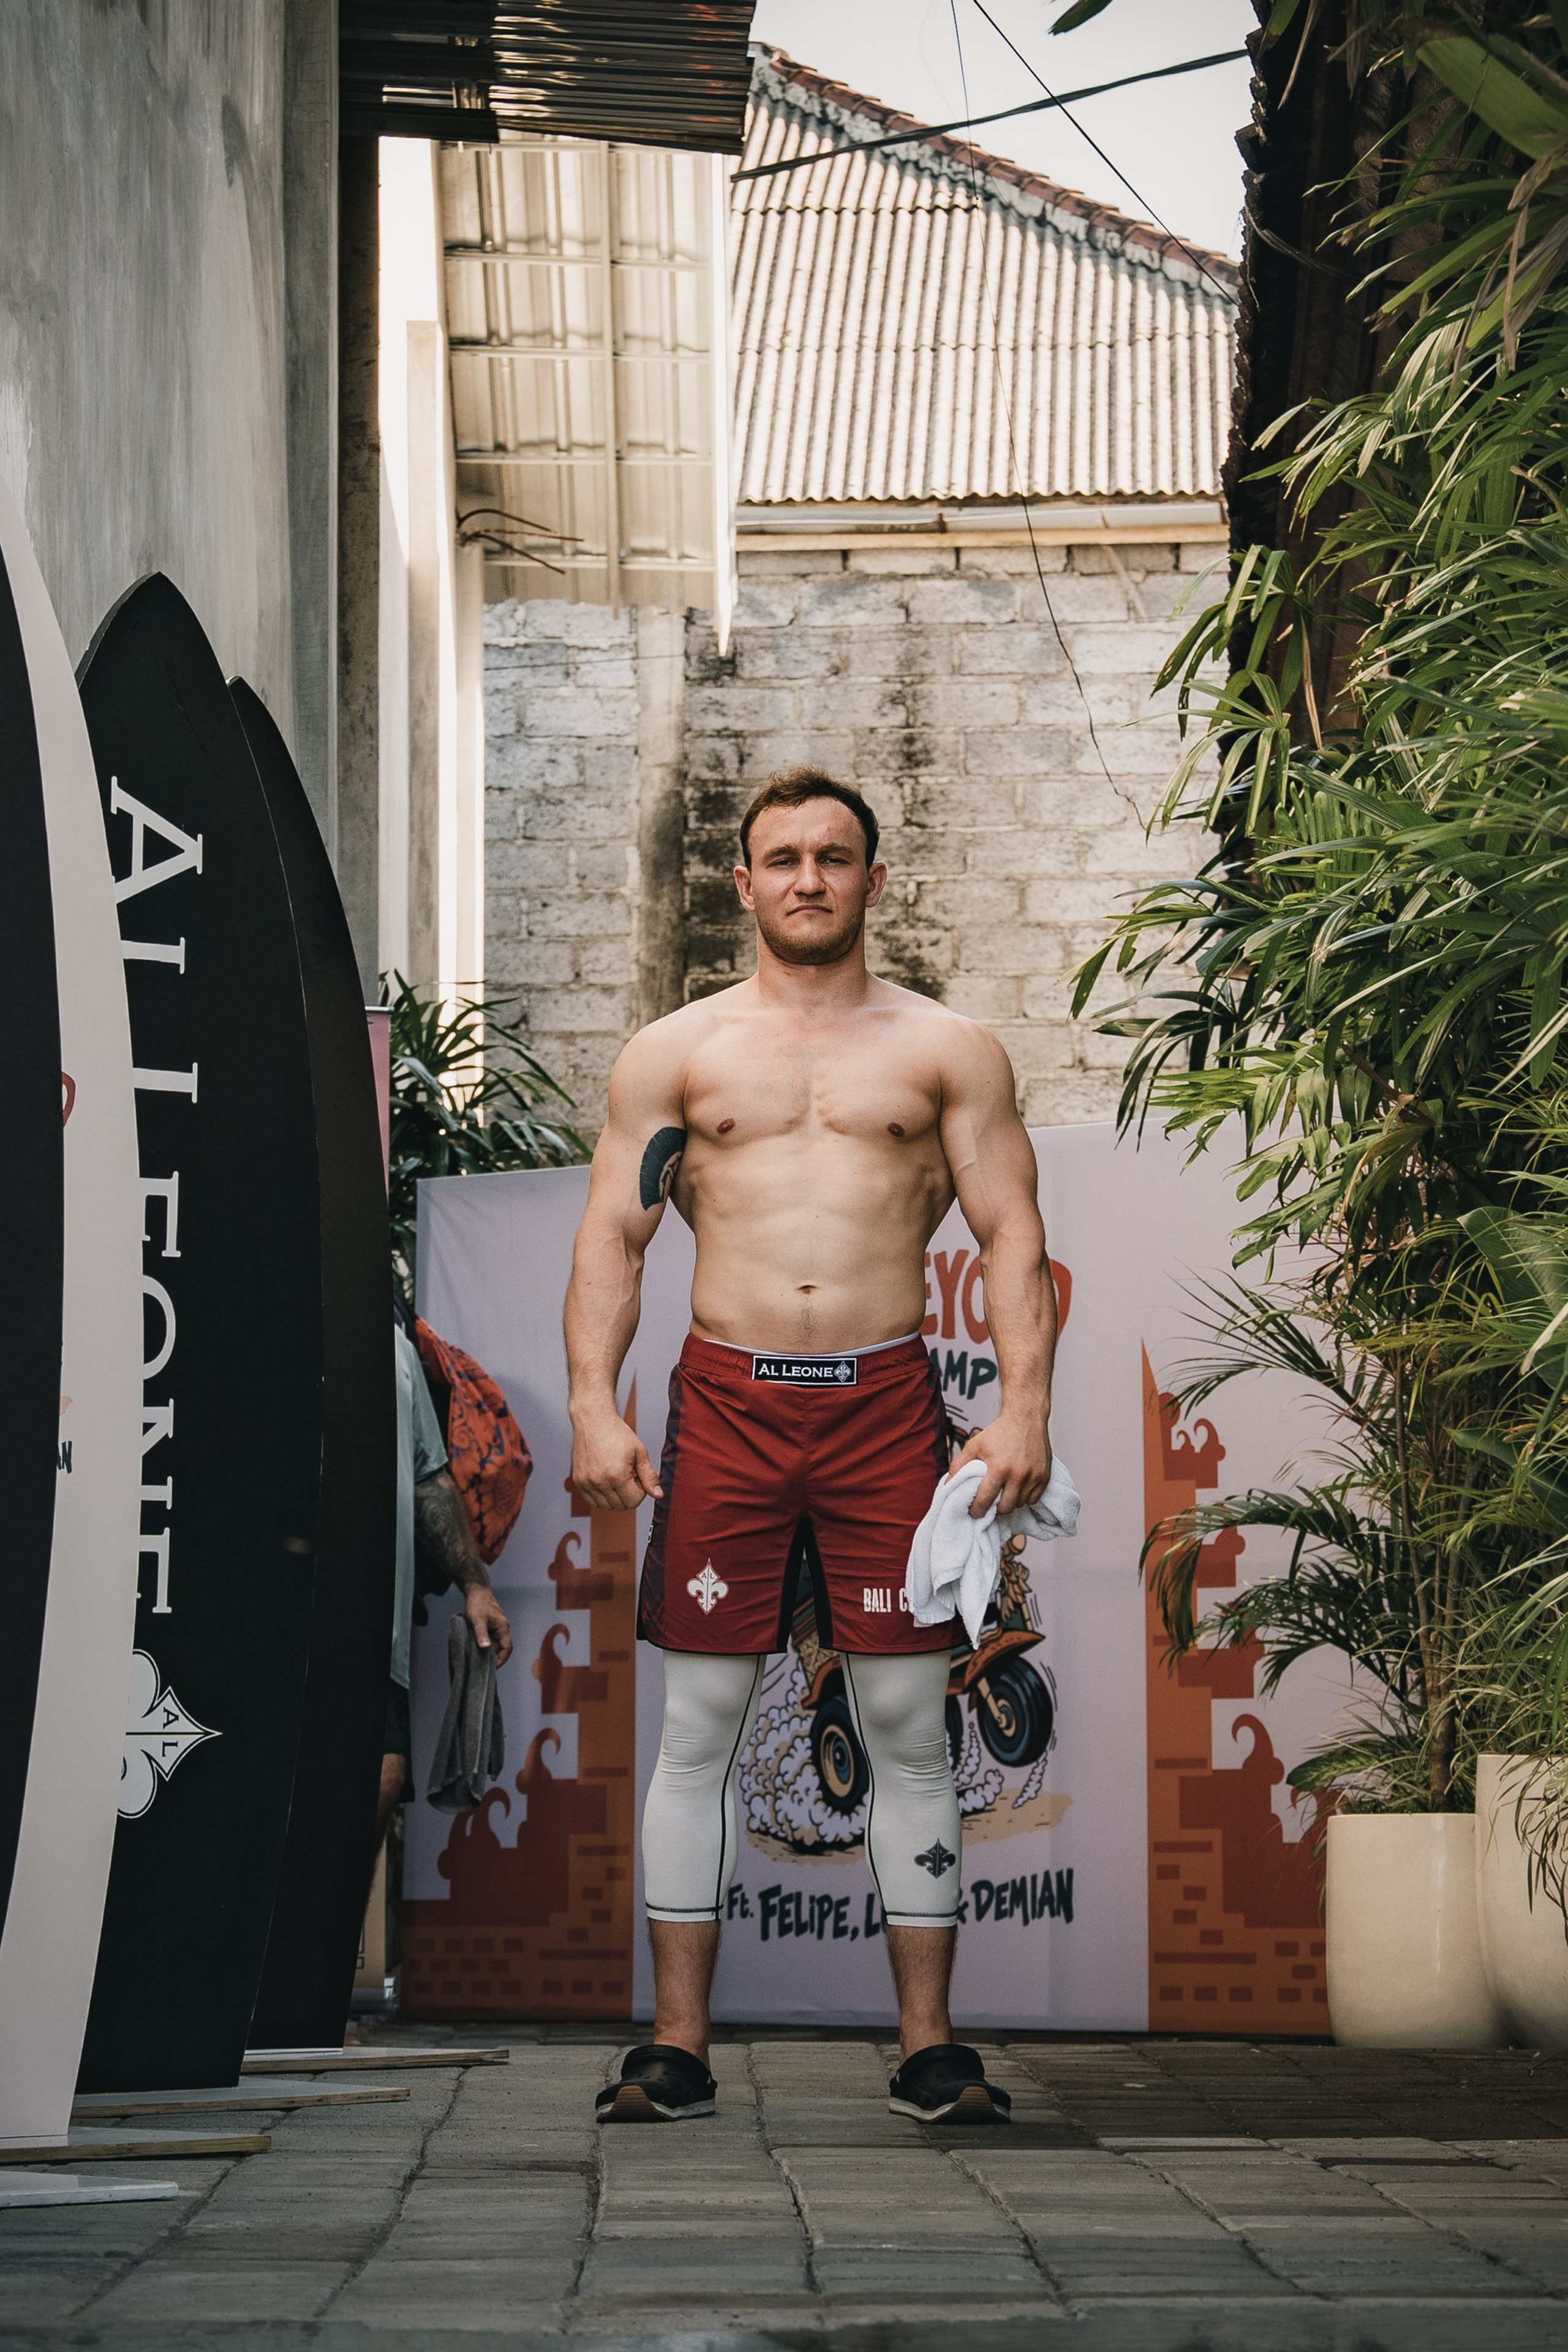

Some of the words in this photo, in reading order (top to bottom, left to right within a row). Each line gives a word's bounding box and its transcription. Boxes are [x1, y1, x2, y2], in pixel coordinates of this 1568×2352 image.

[758, 1363, 778, 1376] AL
[782, 1364, 833, 1378] LEONE
[864, 1588, 891, 1613] BALI
[727, 1883, 754, 1920] Ft.
[971, 1868, 1074, 1927] DEMIAN
